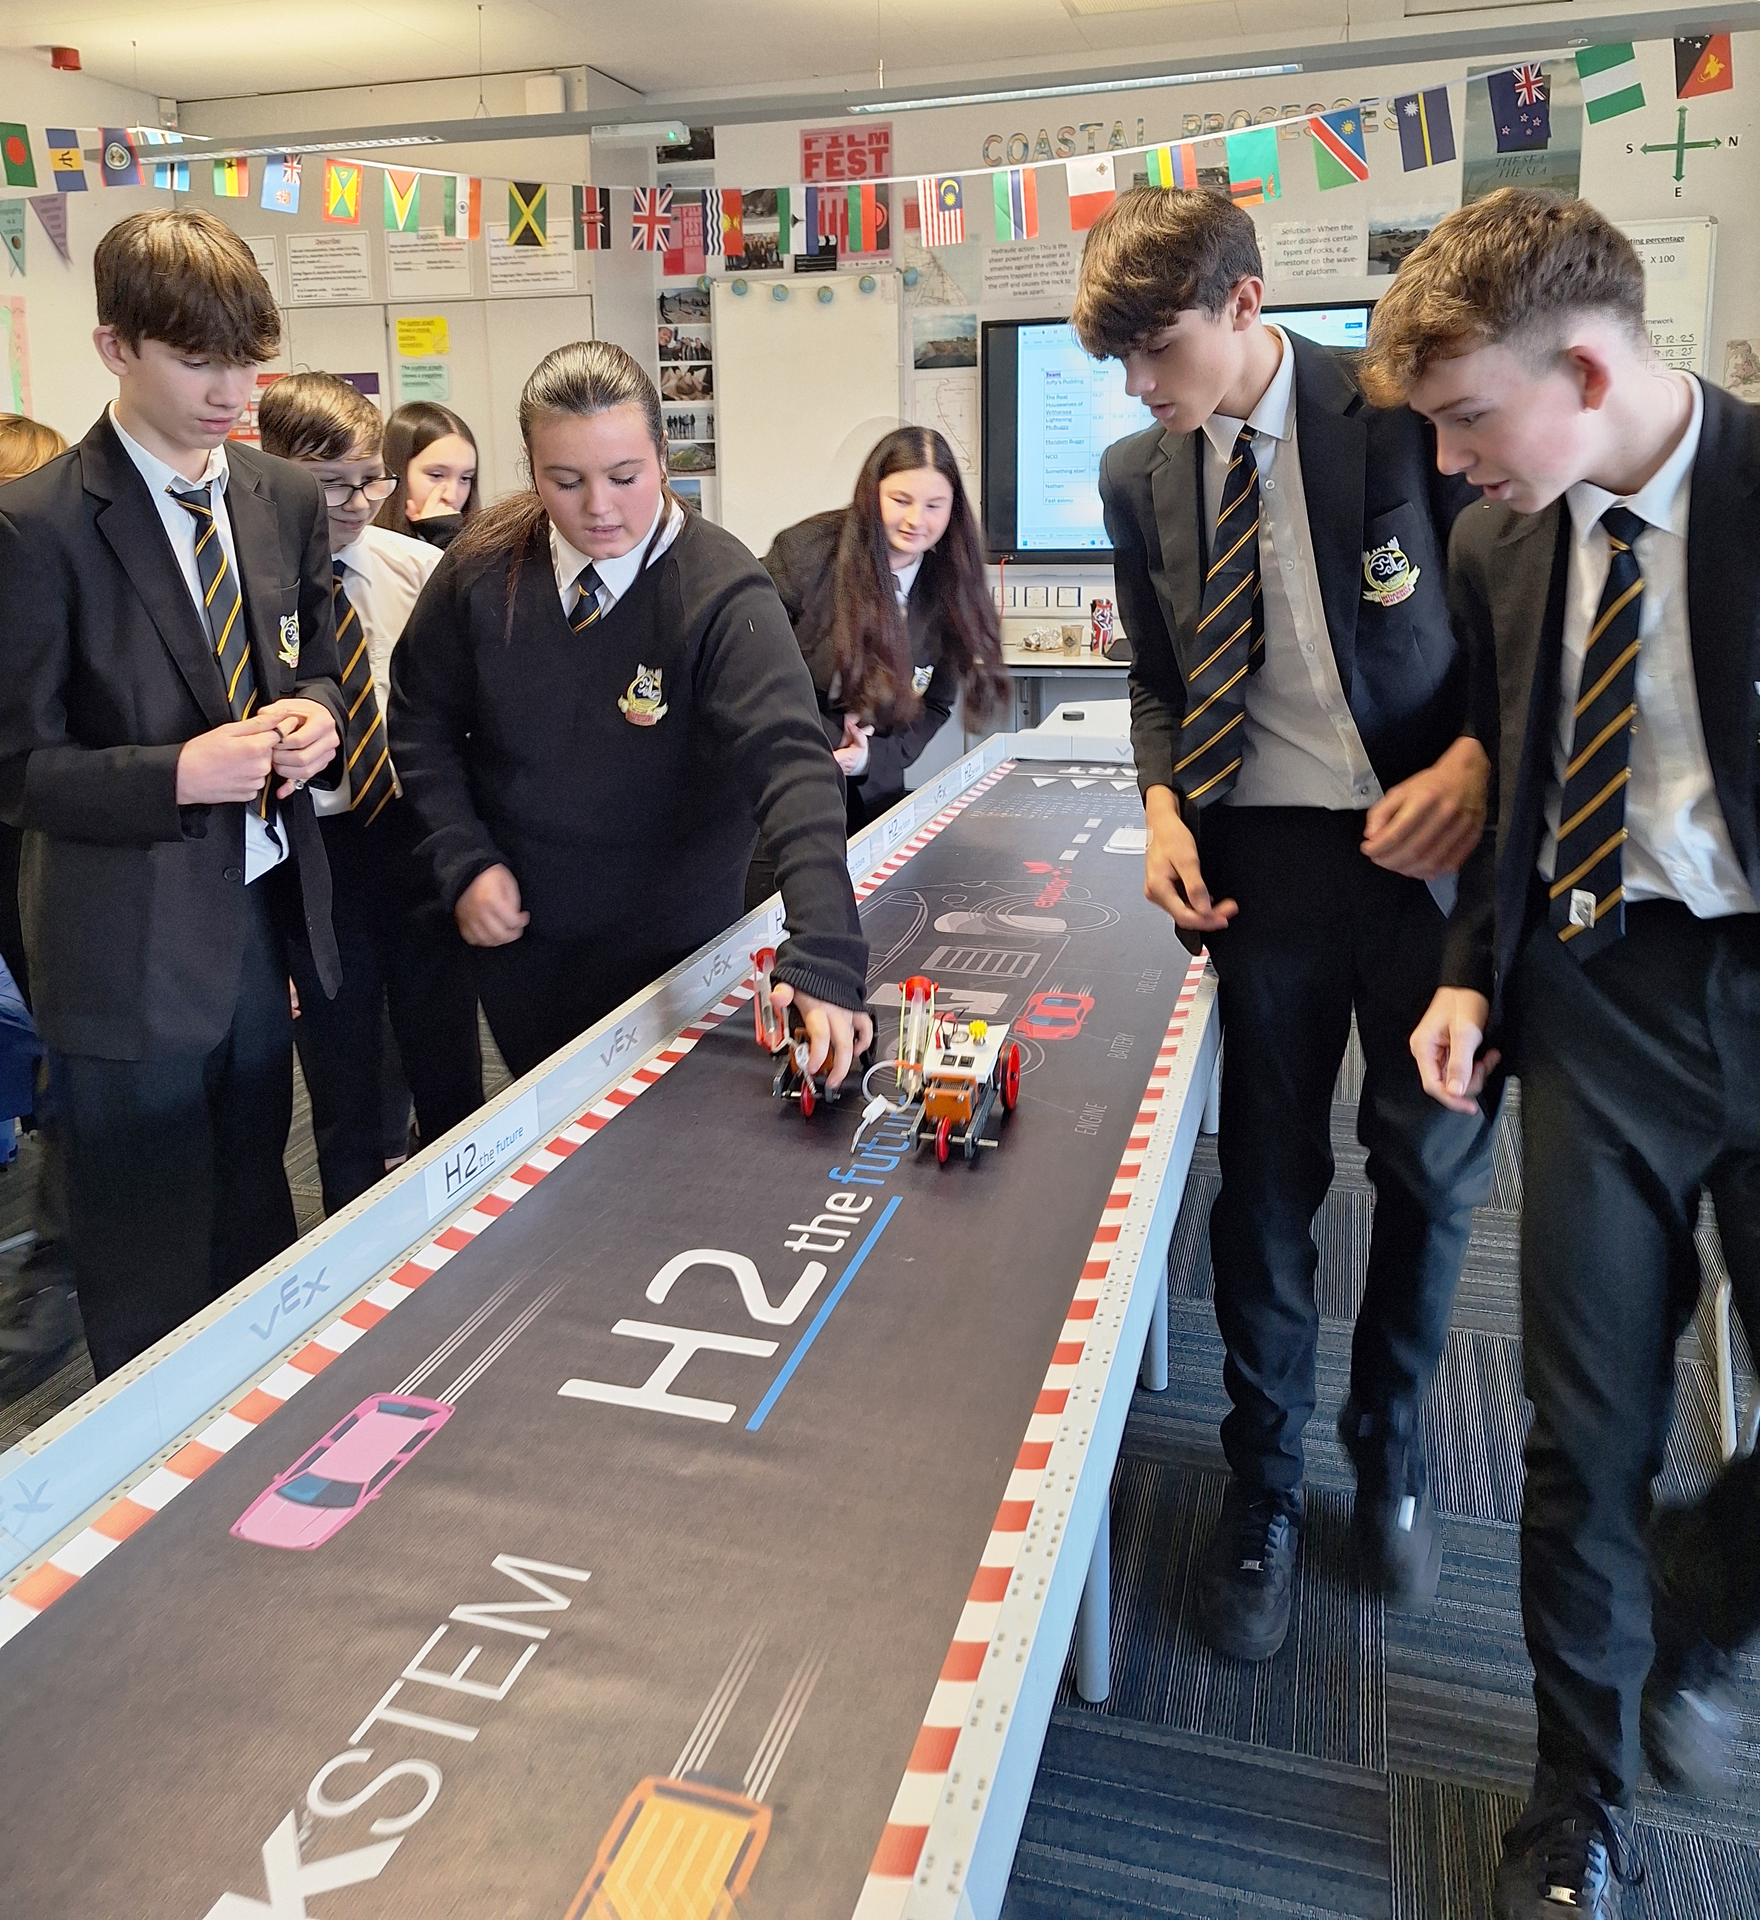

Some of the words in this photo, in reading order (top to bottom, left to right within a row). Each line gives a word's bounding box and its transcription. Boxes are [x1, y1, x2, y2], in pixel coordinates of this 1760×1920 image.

[804, 131, 889, 151] FILM
[982, 118, 1144, 167] COASTAL
[1728, 136, 1739, 147] N
[1626, 143, 1634, 154] S
[804, 146, 889, 179] FEST
[1674, 187, 1682, 198] E
[1281, 227, 1311, 236] Solution
[1317, 225, 1340, 233] When
[1341, 223, 1354, 231] the
[1298, 236, 1331, 245] dissolves
[1332, 234, 1358, 242] certain
[1645, 235, 1686, 245] percentage
[1283, 249, 1303, 257] types
[1304, 247, 1313, 255] of
[1274, 258, 1310, 267] limestone
[1322, 256, 1335, 264] the
[1659, 254, 1676, 264] 100
[1014, 263, 1034, 271] against
[1292, 269, 1304, 277] cut
[1305, 267, 1339, 277] platform.
[1010, 272, 1032, 280] trapped
[1639, 317, 1675, 326] omework
[888, 819, 899, 840] H2
[702, 953, 733, 988] VEX
[599, 1026, 639, 1068] VEX
[1106, 1031, 1137, 1060] BATTERY
[1074, 1101, 1108, 1136] ENGINE
[445, 1142, 479, 1193] H2
[479, 1148, 495, 1168] the
[495, 1126, 524, 1155] future
[249, 1266, 331, 1341] VEX
[556, 1248, 828, 1424] H2
[783, 1191, 873, 1253] the
